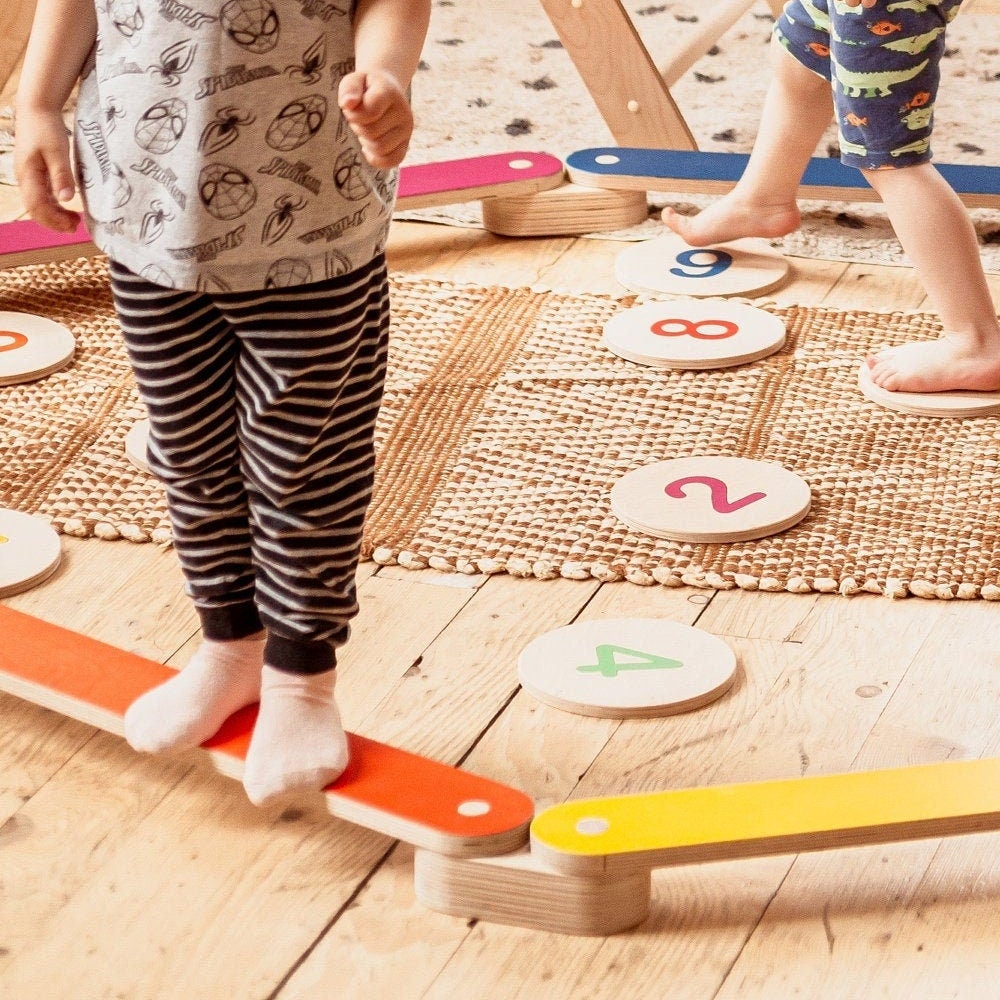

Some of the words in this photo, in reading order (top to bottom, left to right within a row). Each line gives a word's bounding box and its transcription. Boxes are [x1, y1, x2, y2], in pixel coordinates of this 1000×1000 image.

[650, 317, 740, 341] 8
[665, 475, 767, 514] 2
[576, 643, 683, 678] 4
